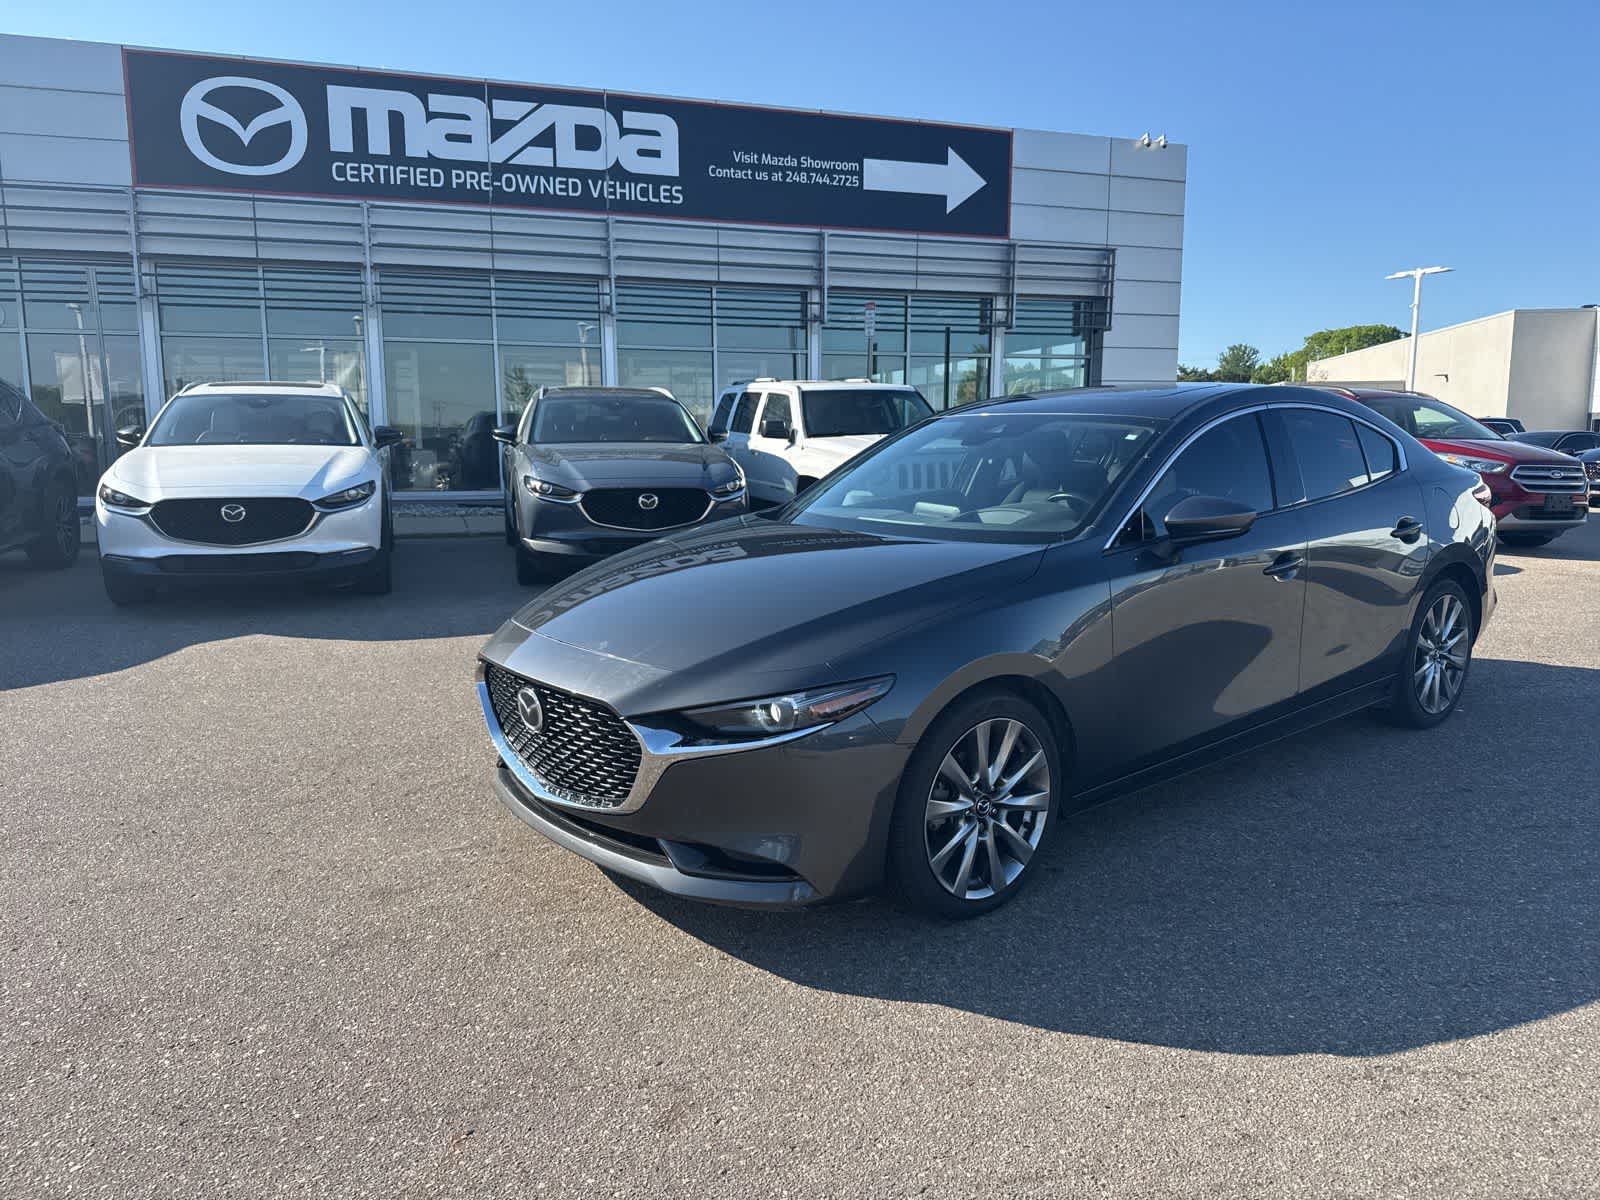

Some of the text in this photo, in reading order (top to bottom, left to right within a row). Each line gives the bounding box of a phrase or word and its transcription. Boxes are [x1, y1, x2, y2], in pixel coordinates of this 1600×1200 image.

[733, 151, 859, 171] Visit Mazda Showroom
[331, 161, 684, 205] CERTIFIED PRE-OWNED VEHICLES
[708, 165, 859, 187] Contact us at 248.744.2725
